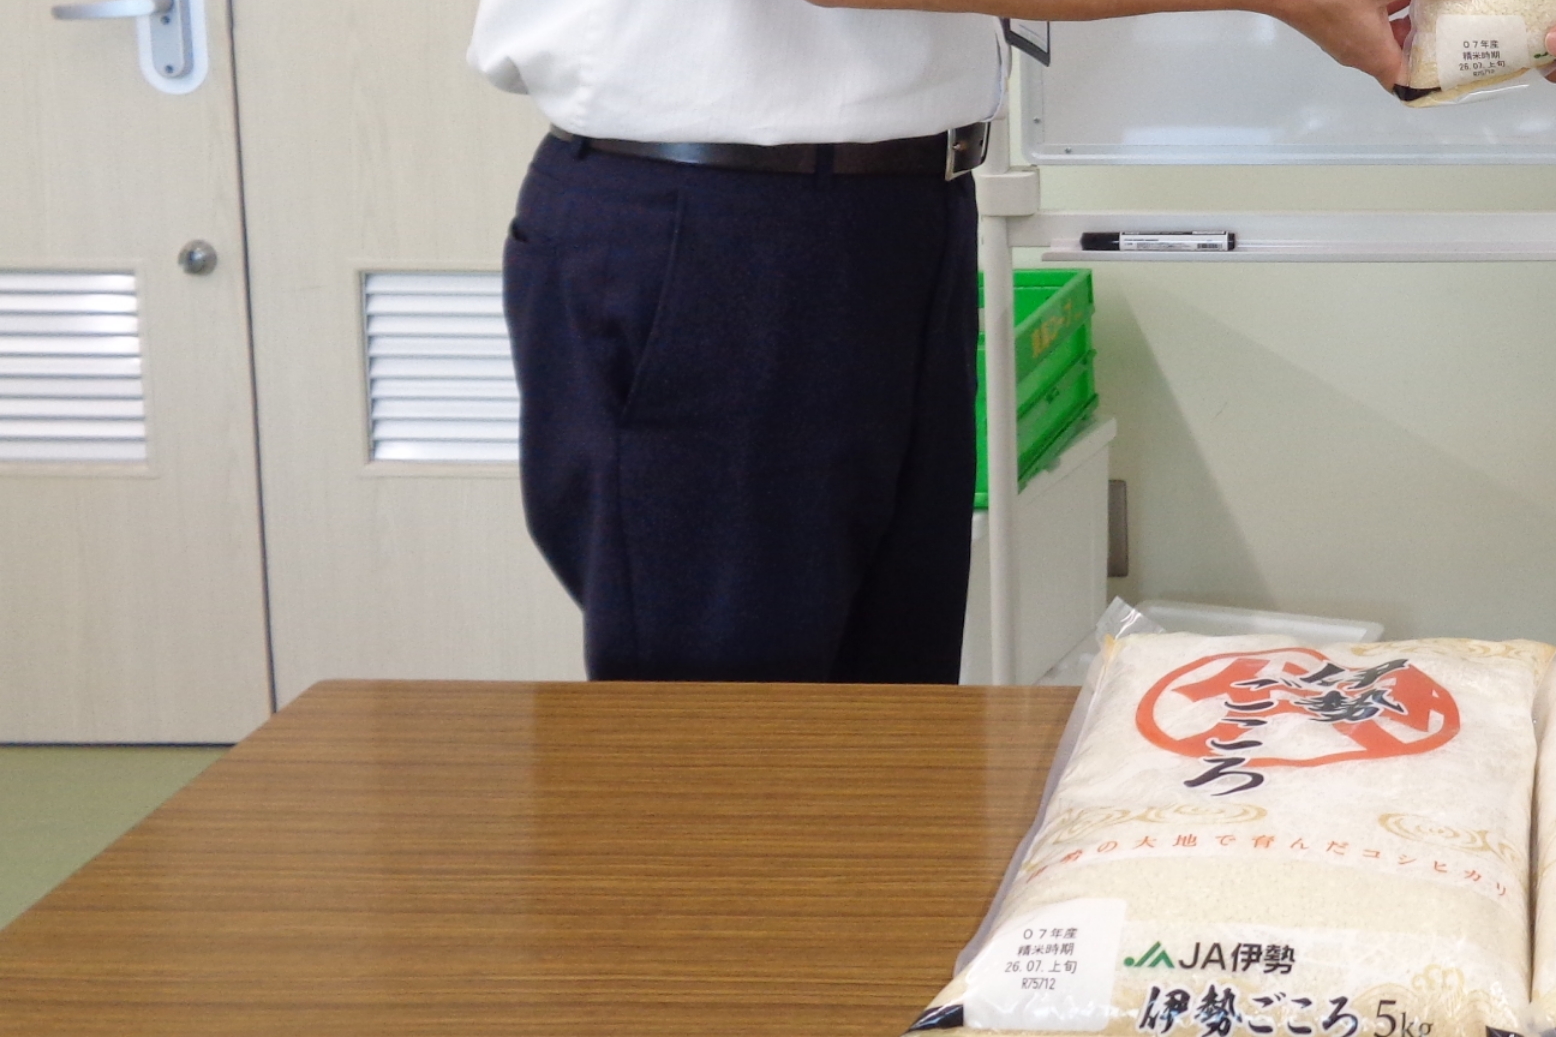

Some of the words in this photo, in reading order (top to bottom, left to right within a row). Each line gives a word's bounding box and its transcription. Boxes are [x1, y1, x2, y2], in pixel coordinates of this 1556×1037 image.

[1178, 942, 1296, 975] JA伊勢
[1139, 984, 1359, 1037] 伊勢ごころ
